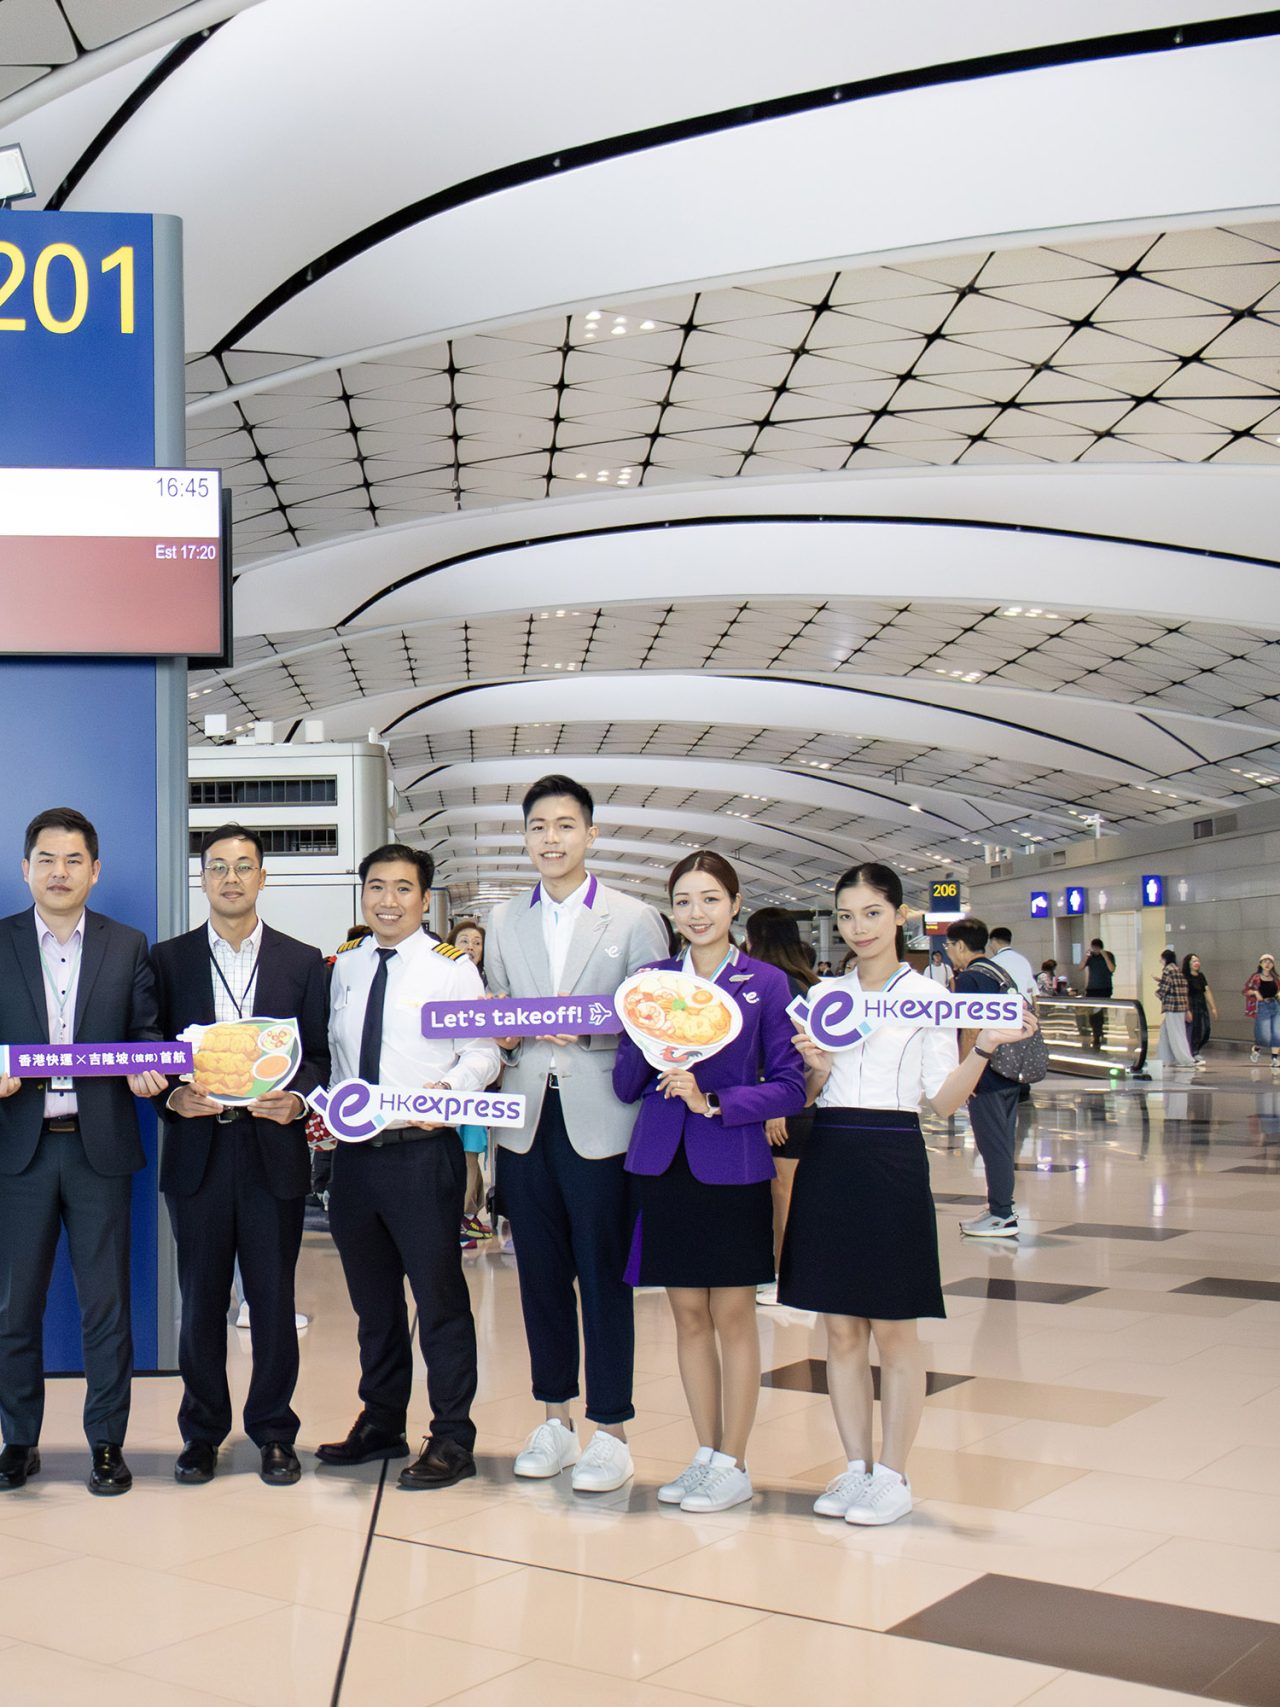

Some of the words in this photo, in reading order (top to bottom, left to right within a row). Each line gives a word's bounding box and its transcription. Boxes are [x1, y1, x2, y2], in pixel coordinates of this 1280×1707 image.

[156, 477, 209, 498] 16:45
[155, 544, 177, 560] Est
[180, 545, 216, 560] 17:20
[933, 884, 957, 897] 206
[431, 1009, 486, 1028] Let's
[493, 1005, 582, 1026] takeoff!
[865, 999, 1018, 1025] HKexpress
[380, 1093, 521, 1121] HKexpress
